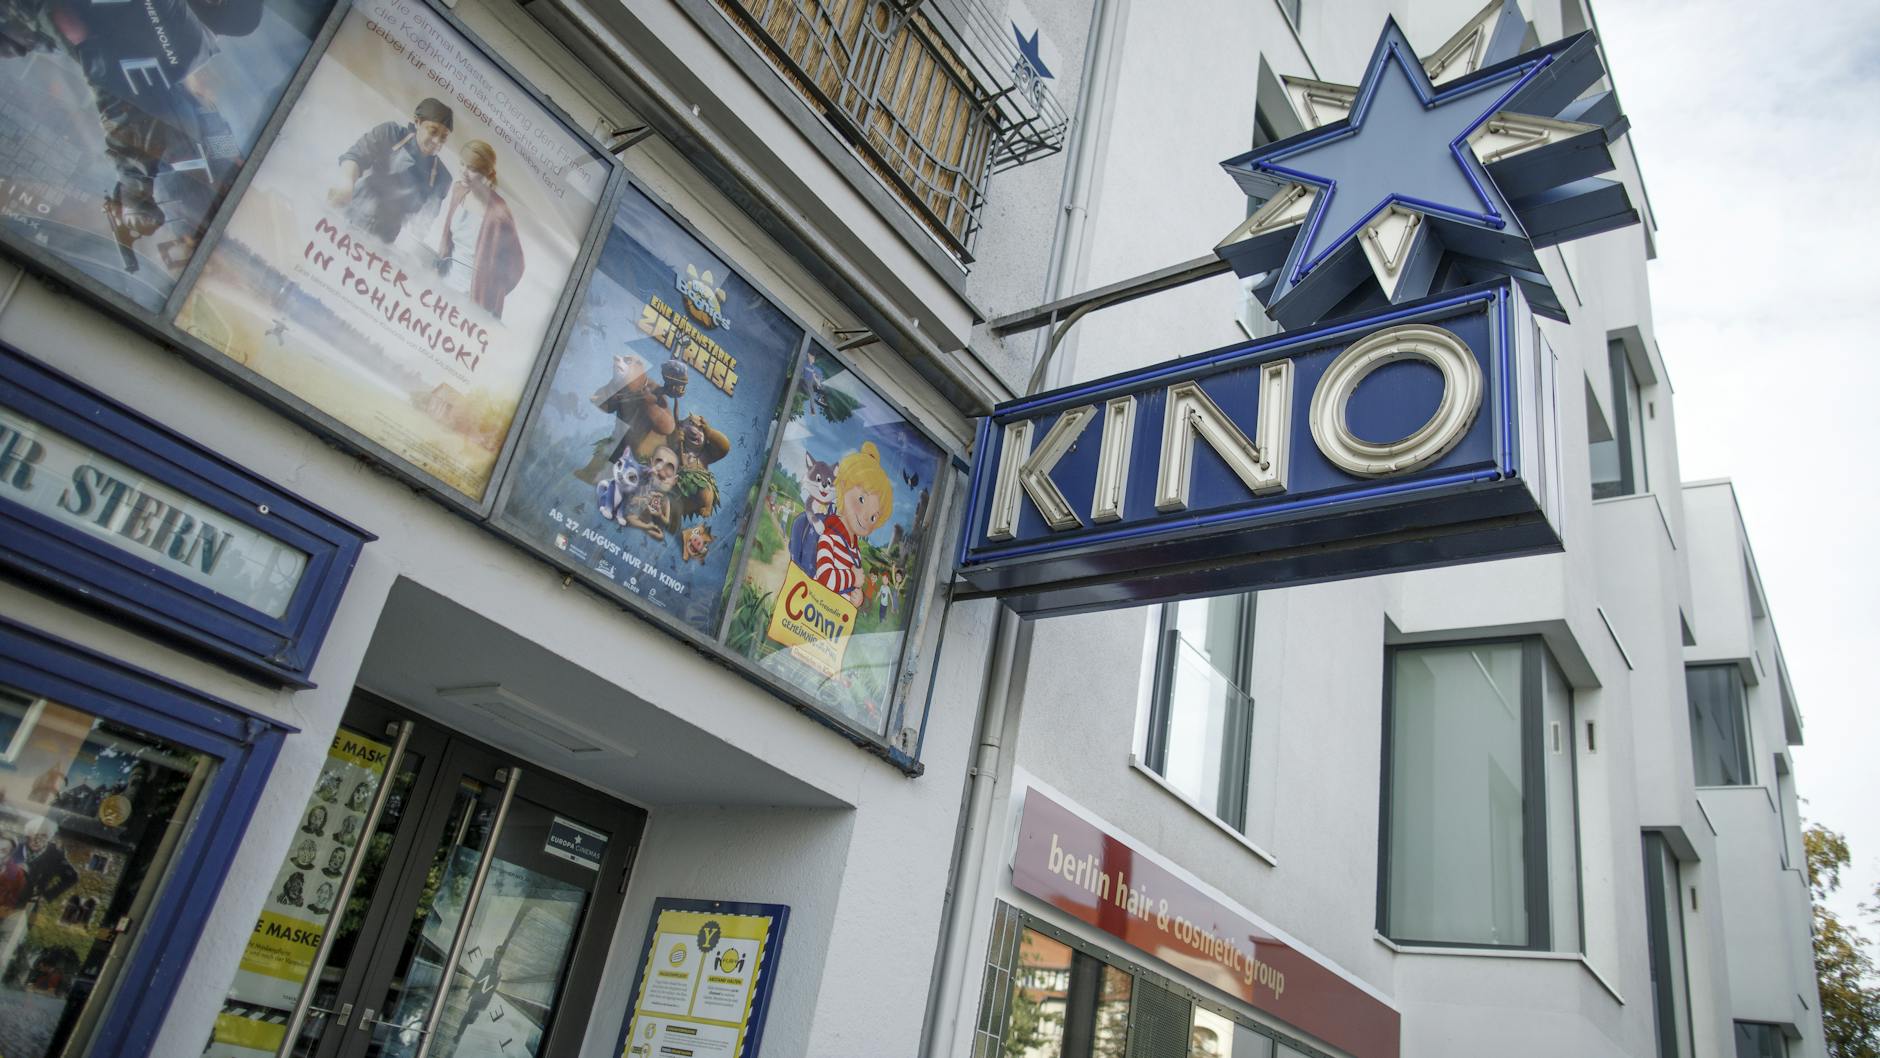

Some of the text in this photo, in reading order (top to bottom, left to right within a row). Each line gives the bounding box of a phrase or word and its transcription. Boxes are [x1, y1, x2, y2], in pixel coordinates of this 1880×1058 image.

[155, 26, 179, 65] NOLAN
[374, 6, 397, 24] die
[400, 22, 467, 84] Kochkunst
[540, 154, 563, 177] und
[366, 20, 407, 54] dabei
[407, 51, 426, 70] für
[427, 69, 455, 94] sich
[457, 92, 493, 126] selbst
[494, 124, 513, 143] die
[542, 171, 567, 199] fand
[413, 14, 455, 53] einmal
[455, 51, 493, 93] Master
[495, 91, 532, 131] Cheng
[534, 127, 556, 151] den
[557, 145, 592, 182] Finnen
[304, 241, 335, 271] IN
[342, 267, 480, 372] POHJANJOKI
[315, 218, 412, 298] MASTER
[419, 289, 489, 354] CHENG
[673, 312, 738, 370] BÄRENSTARKE
[987, 323, 1484, 541] KINO
[58, 464, 234, 576] STERN
[548, 508, 563, 523] AB
[565, 517, 580, 533] 27.
[582, 528, 621, 556] AUGUST
[622, 551, 642, 569] NUR
[643, 563, 658, 578] IM
[659, 572, 686, 594] KINO!
[785, 580, 849, 643] Conni
[342, 740, 386, 765] MASK
[551, 835, 601, 859] EUROPA CINEMAS
[266, 922, 321, 948] MASKE
[703, 927, 718, 948] Y
[1047, 834, 1286, 999] berlin hair & cosmetic group
